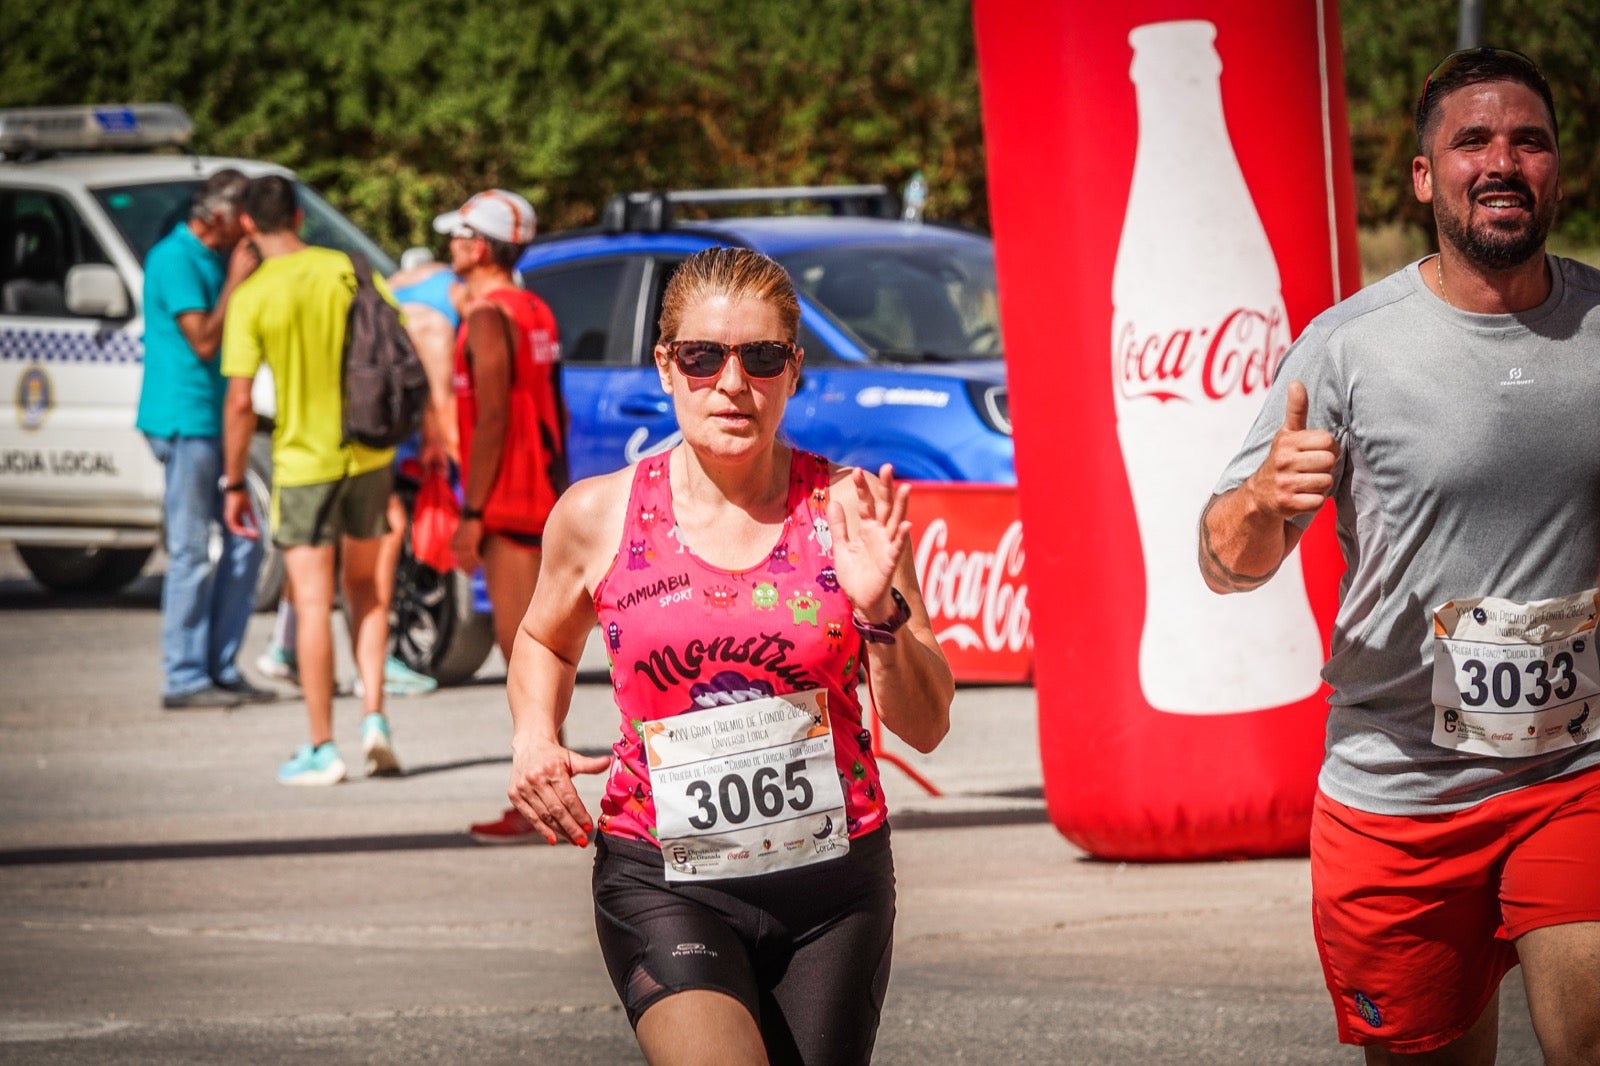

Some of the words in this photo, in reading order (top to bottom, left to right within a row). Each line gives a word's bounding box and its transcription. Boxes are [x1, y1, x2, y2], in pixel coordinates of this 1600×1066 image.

[616, 572, 690, 611] KAMUABU
[658, 588, 694, 608] SPORT
[914, 518, 1035, 653] Coca-Co
[1566, 602, 1586, 618] 2022
[1460, 651, 1577, 708] 3033
[690, 724, 712, 739] GRAN
[713, 718, 744, 736] PREMIO
[746, 716, 757, 727] DE
[758, 710, 785, 726] FONDO
[786, 702, 807, 720] 2022
[711, 734, 745, 750] UNIVERSO
[746, 729, 769, 743] LORCA
[693, 769, 702, 778] DE
[753, 755, 762, 765] DE
[686, 760, 814, 830] 3065
